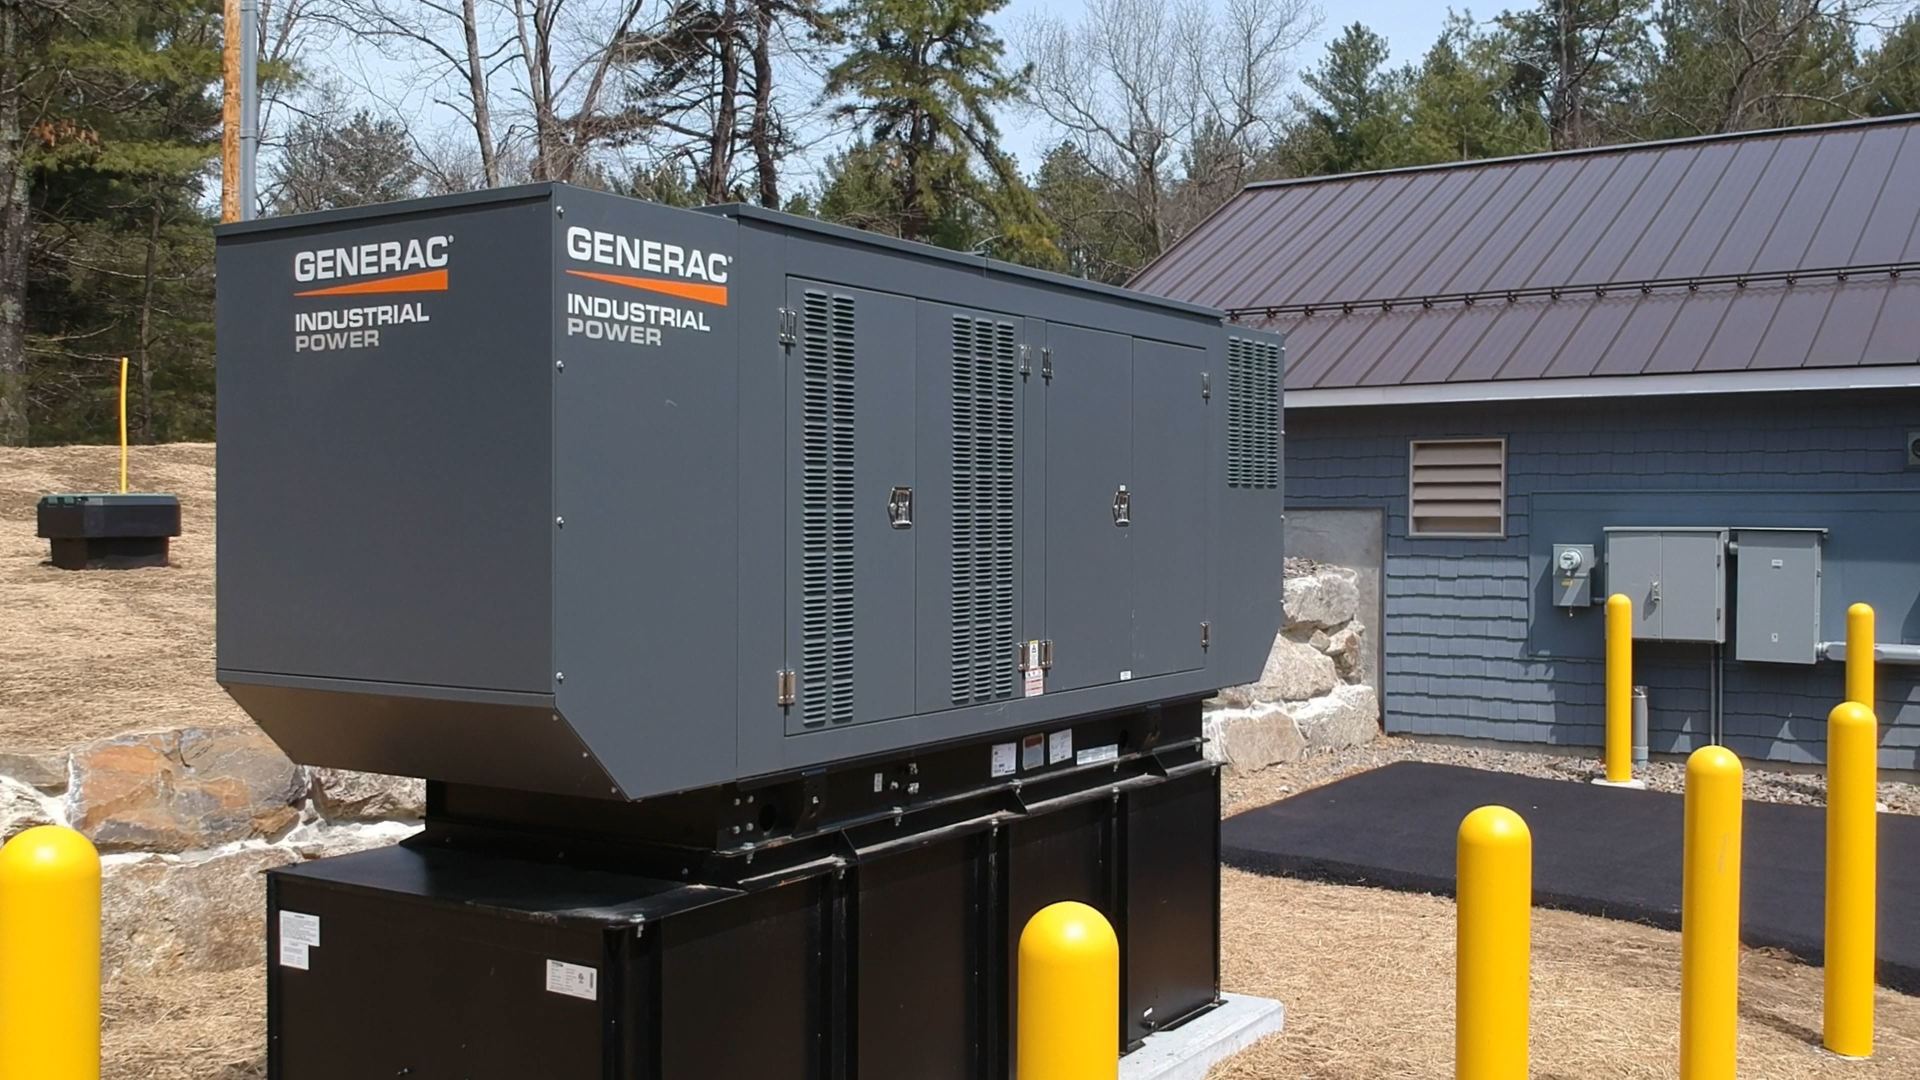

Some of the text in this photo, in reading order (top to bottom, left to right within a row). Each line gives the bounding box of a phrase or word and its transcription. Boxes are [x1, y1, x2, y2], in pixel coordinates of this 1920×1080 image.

[295, 303, 429, 332] INDUSTRIAL
[568, 293, 710, 331] INDUSTRIAL
[295, 330, 379, 352] POWER
[568, 317, 662, 346] POWER
